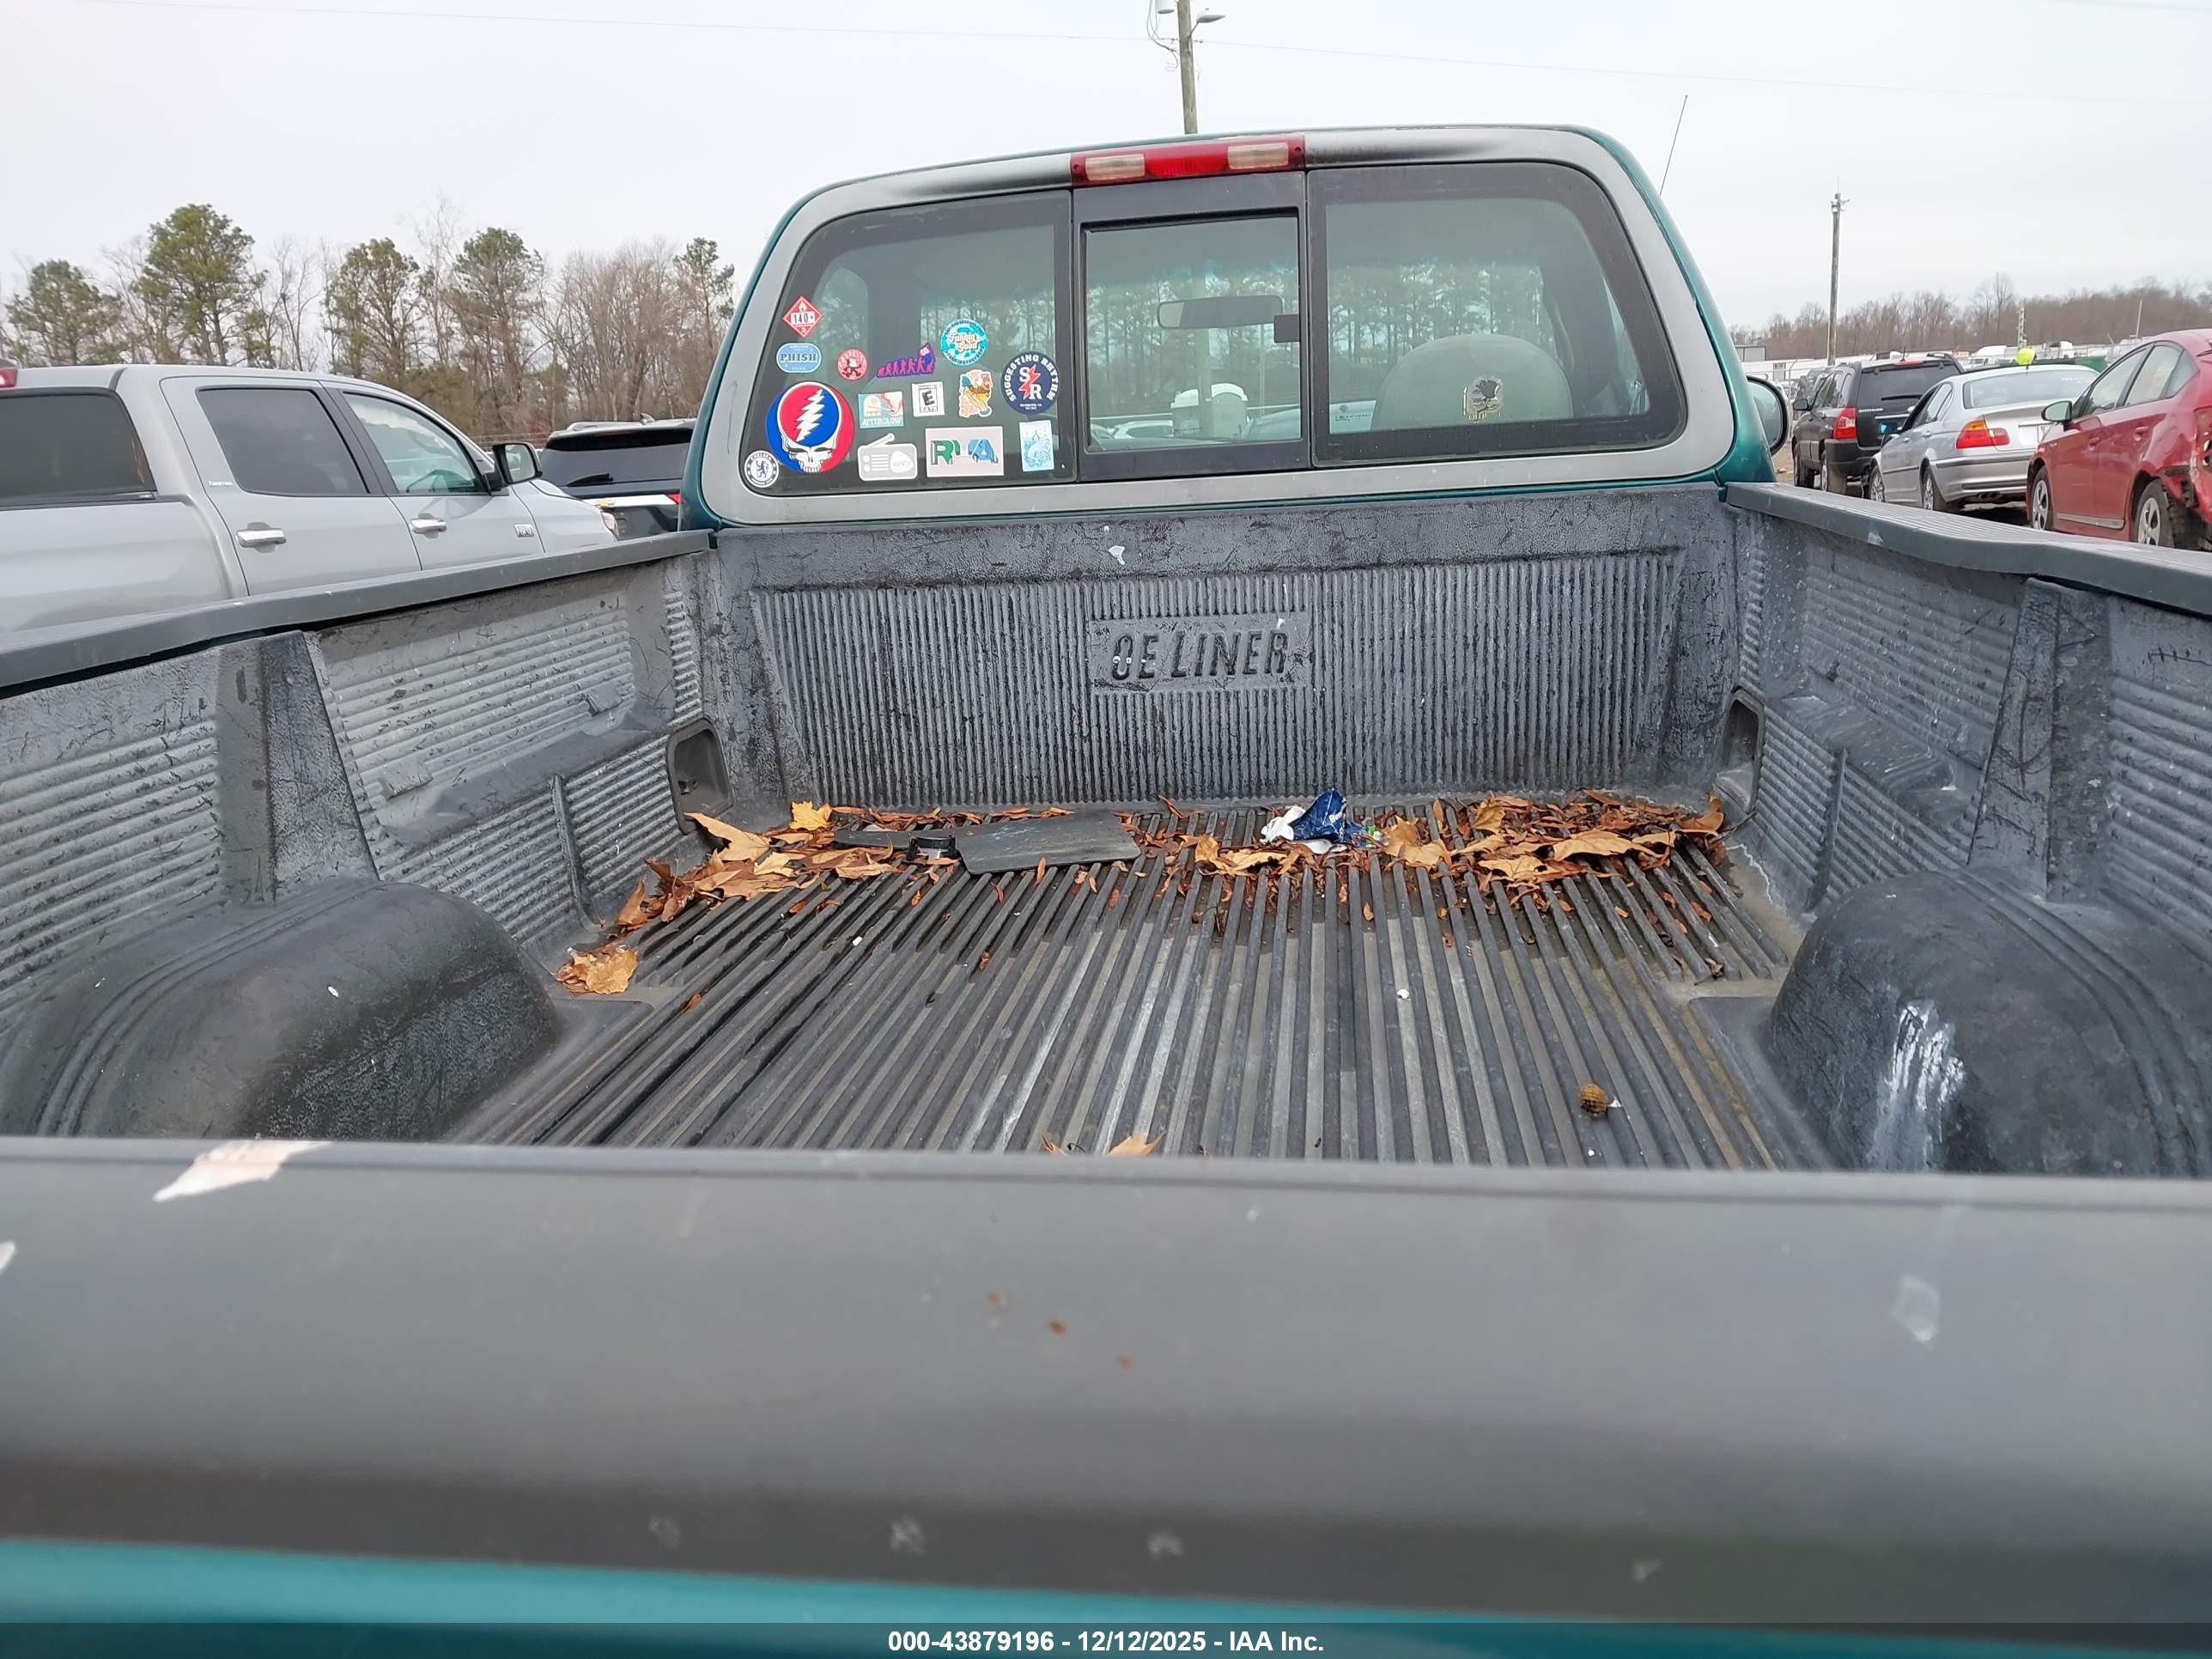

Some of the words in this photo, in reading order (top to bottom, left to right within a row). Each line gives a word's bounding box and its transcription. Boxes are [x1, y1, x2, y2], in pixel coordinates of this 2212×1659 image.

[780, 353, 817, 362] PHISH
[1004, 354, 1040, 402] SUGGESTING
[1040, 356, 1059, 401] RHYTHM
[1170, 630, 1288, 678] LINER
